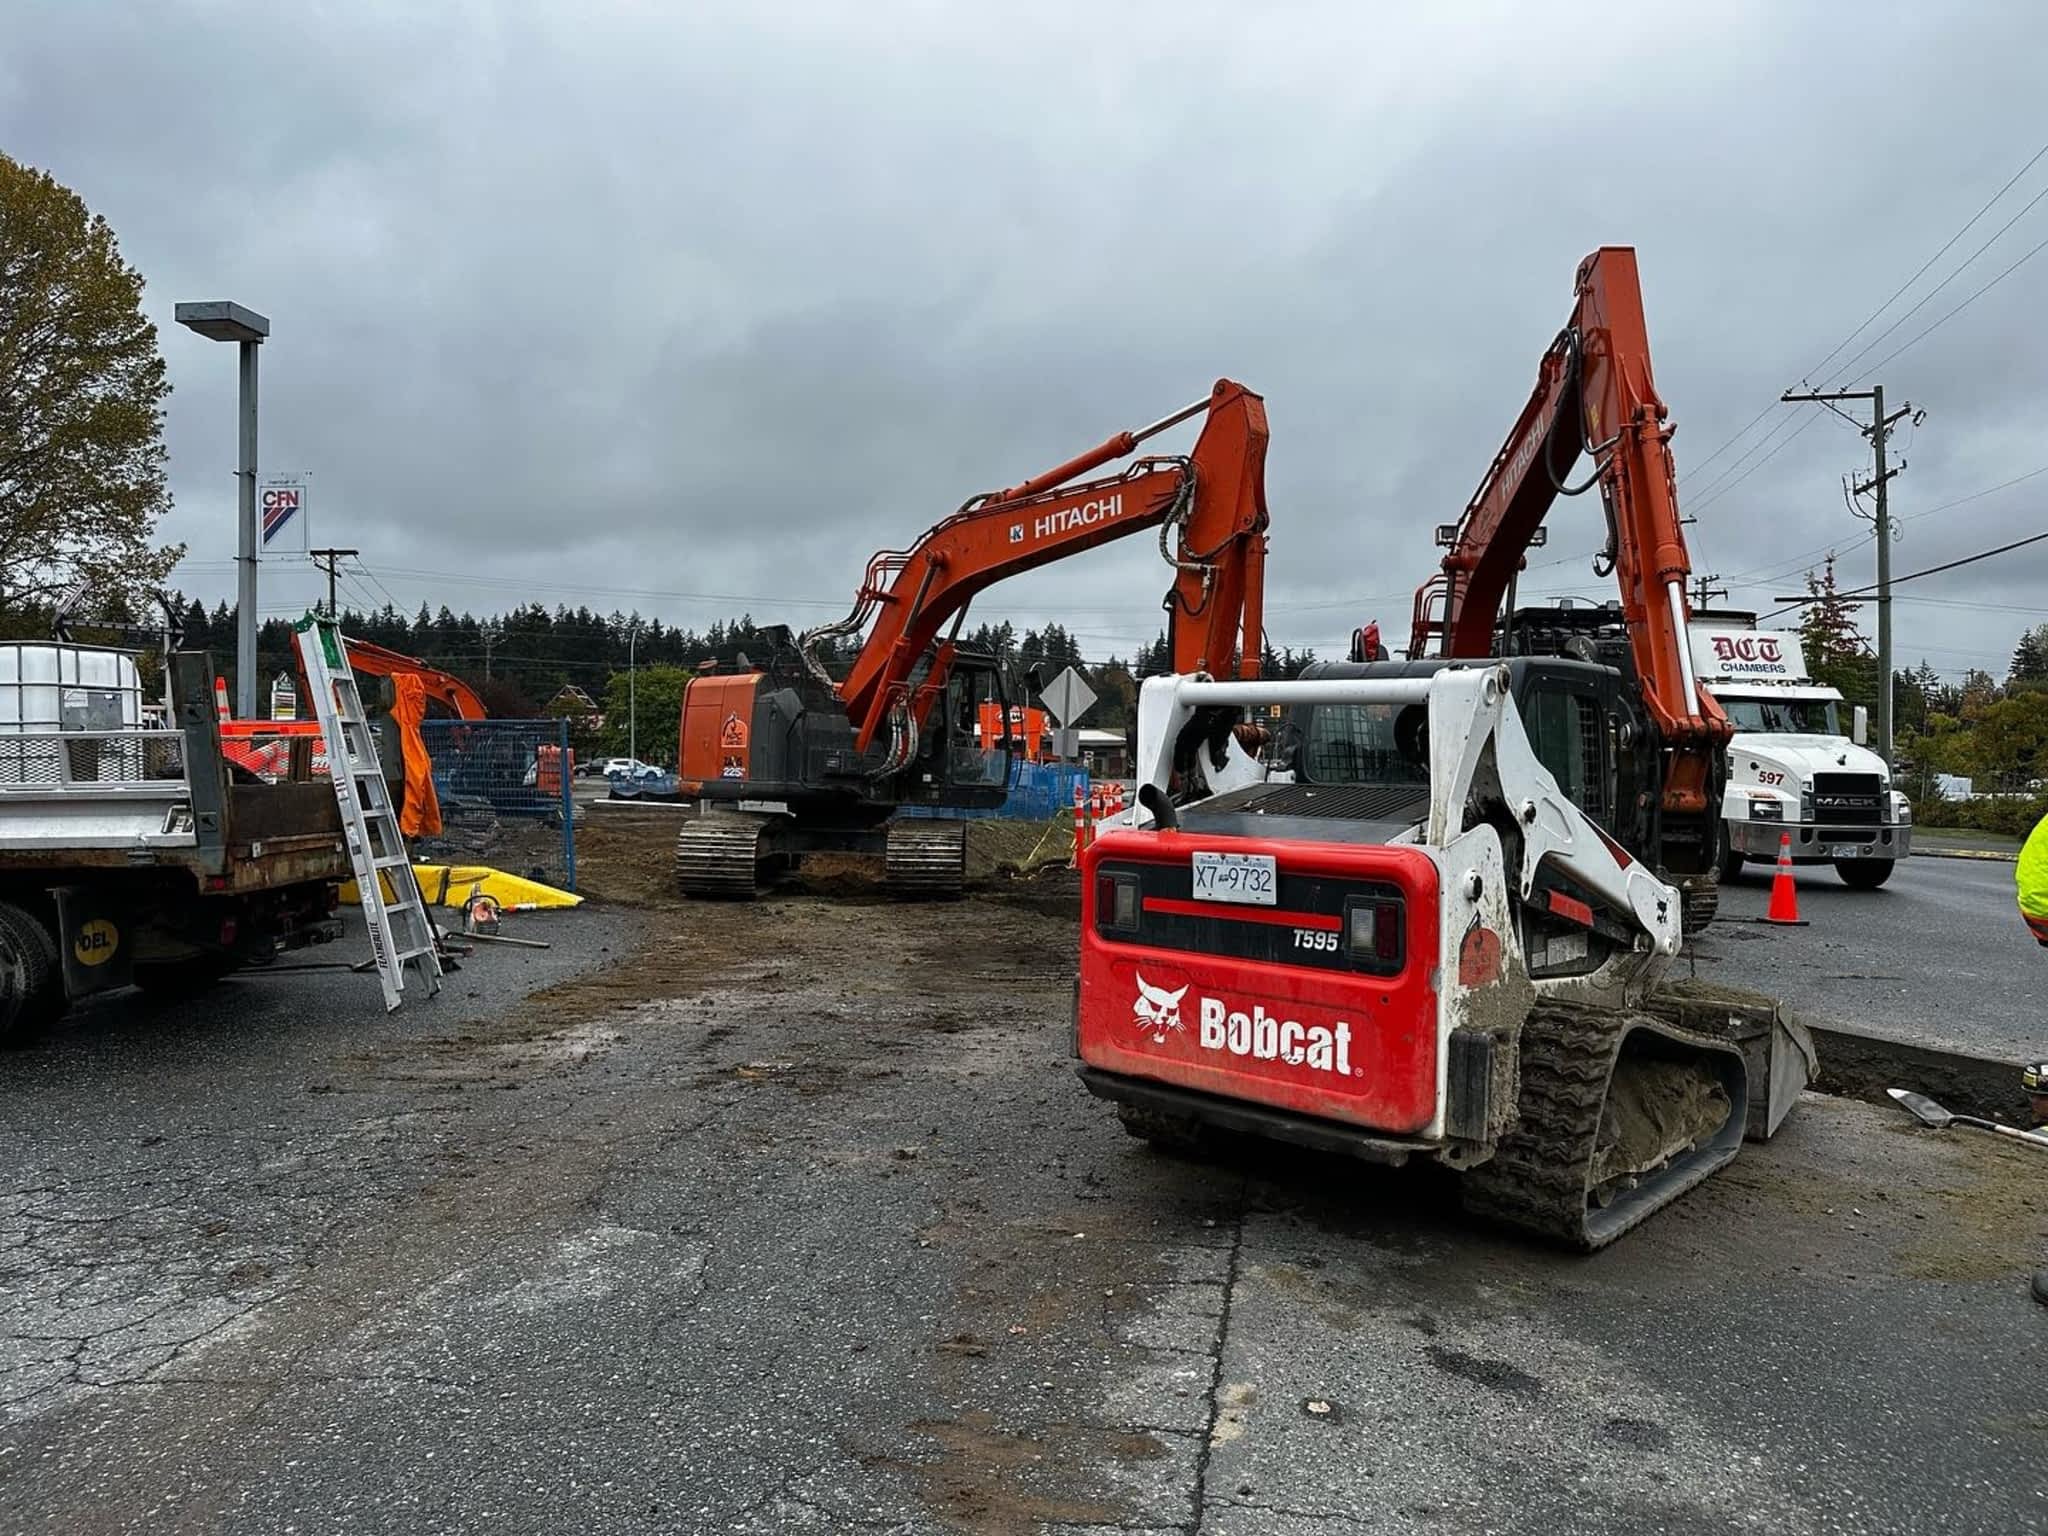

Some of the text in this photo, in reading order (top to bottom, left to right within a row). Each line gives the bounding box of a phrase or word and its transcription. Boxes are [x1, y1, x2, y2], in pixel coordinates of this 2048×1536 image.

[1502, 412, 1544, 501] HITACHI
[262, 490, 299, 507] CFN
[1034, 494, 1123, 538] HITACHI
[1711, 636, 1783, 662] DCT
[1720, 662, 1787, 674] CHAMBERS
[1758, 770, 1785, 786] 597
[1815, 797, 1878, 807] MACK
[368, 920, 389, 969] FEATHERLITE
[1292, 928, 1339, 952] T595
[1200, 996, 1352, 1076] Bobcat
